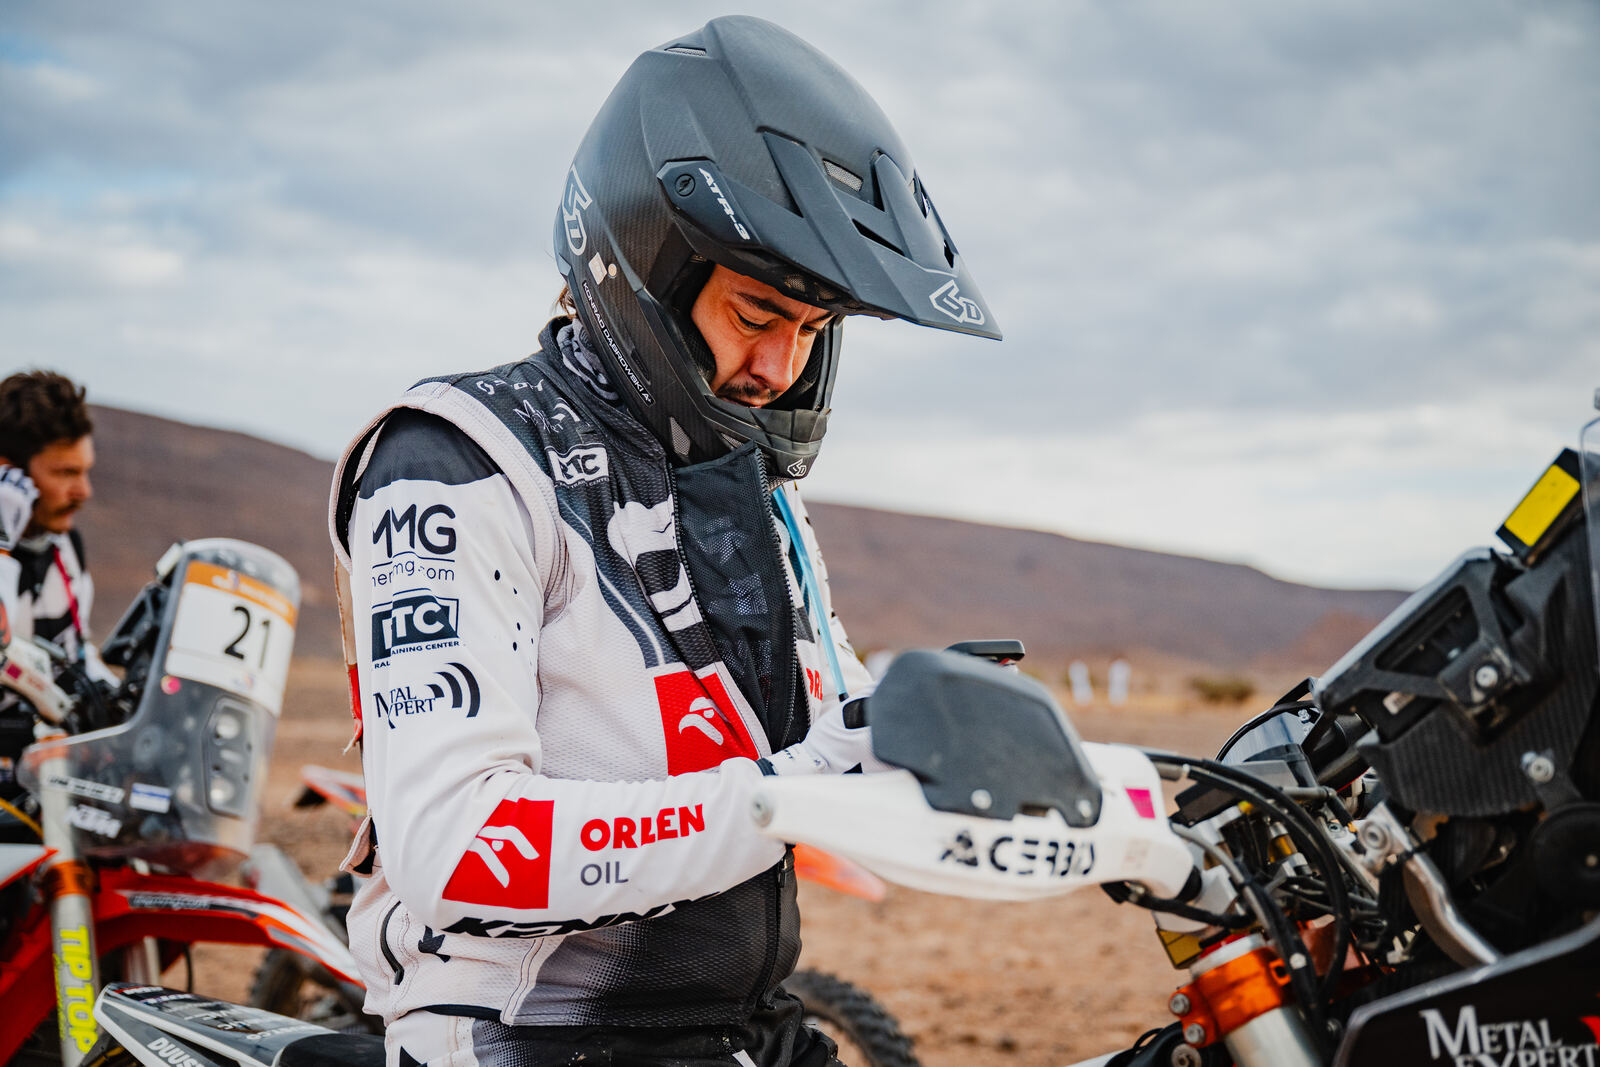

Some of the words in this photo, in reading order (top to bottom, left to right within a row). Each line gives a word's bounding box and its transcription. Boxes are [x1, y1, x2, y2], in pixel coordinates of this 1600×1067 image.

[698, 167, 751, 241] ATR-3
[582, 282, 605, 329] KONRAD
[224, 606, 271, 670] 21
[391, 645, 424, 656] AINING
[425, 640, 460, 651] CENTER
[580, 803, 706, 852] ORLEN
[580, 861, 629, 886] OIL
[59, 925, 92, 980] TIP
[65, 983, 98, 1054] TOP
[1418, 1004, 1562, 1060] METAL
[146, 1036, 206, 1067] DUUS
